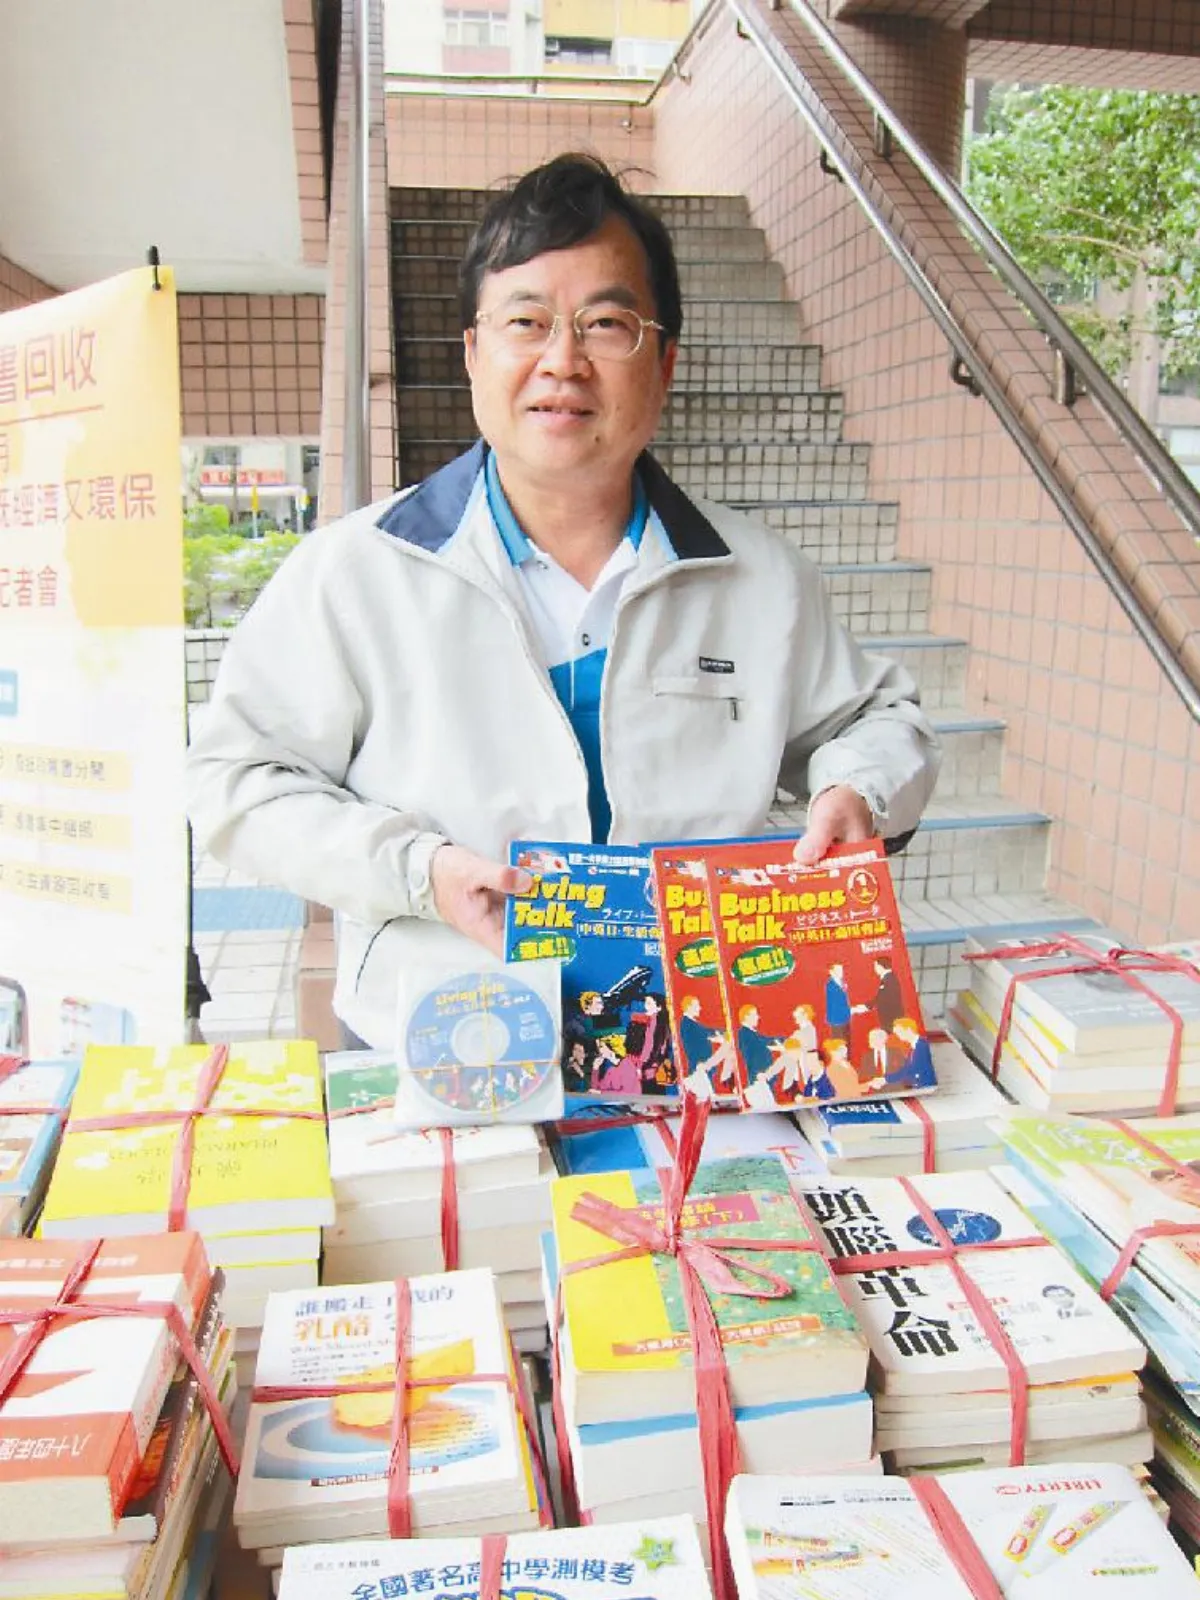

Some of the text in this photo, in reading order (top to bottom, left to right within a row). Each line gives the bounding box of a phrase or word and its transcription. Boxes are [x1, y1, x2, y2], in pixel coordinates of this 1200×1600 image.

[514, 874, 607, 909] iving
[719, 887, 847, 917] Business
[514, 901, 576, 928] Talk
[722, 914, 787, 944] Talk
